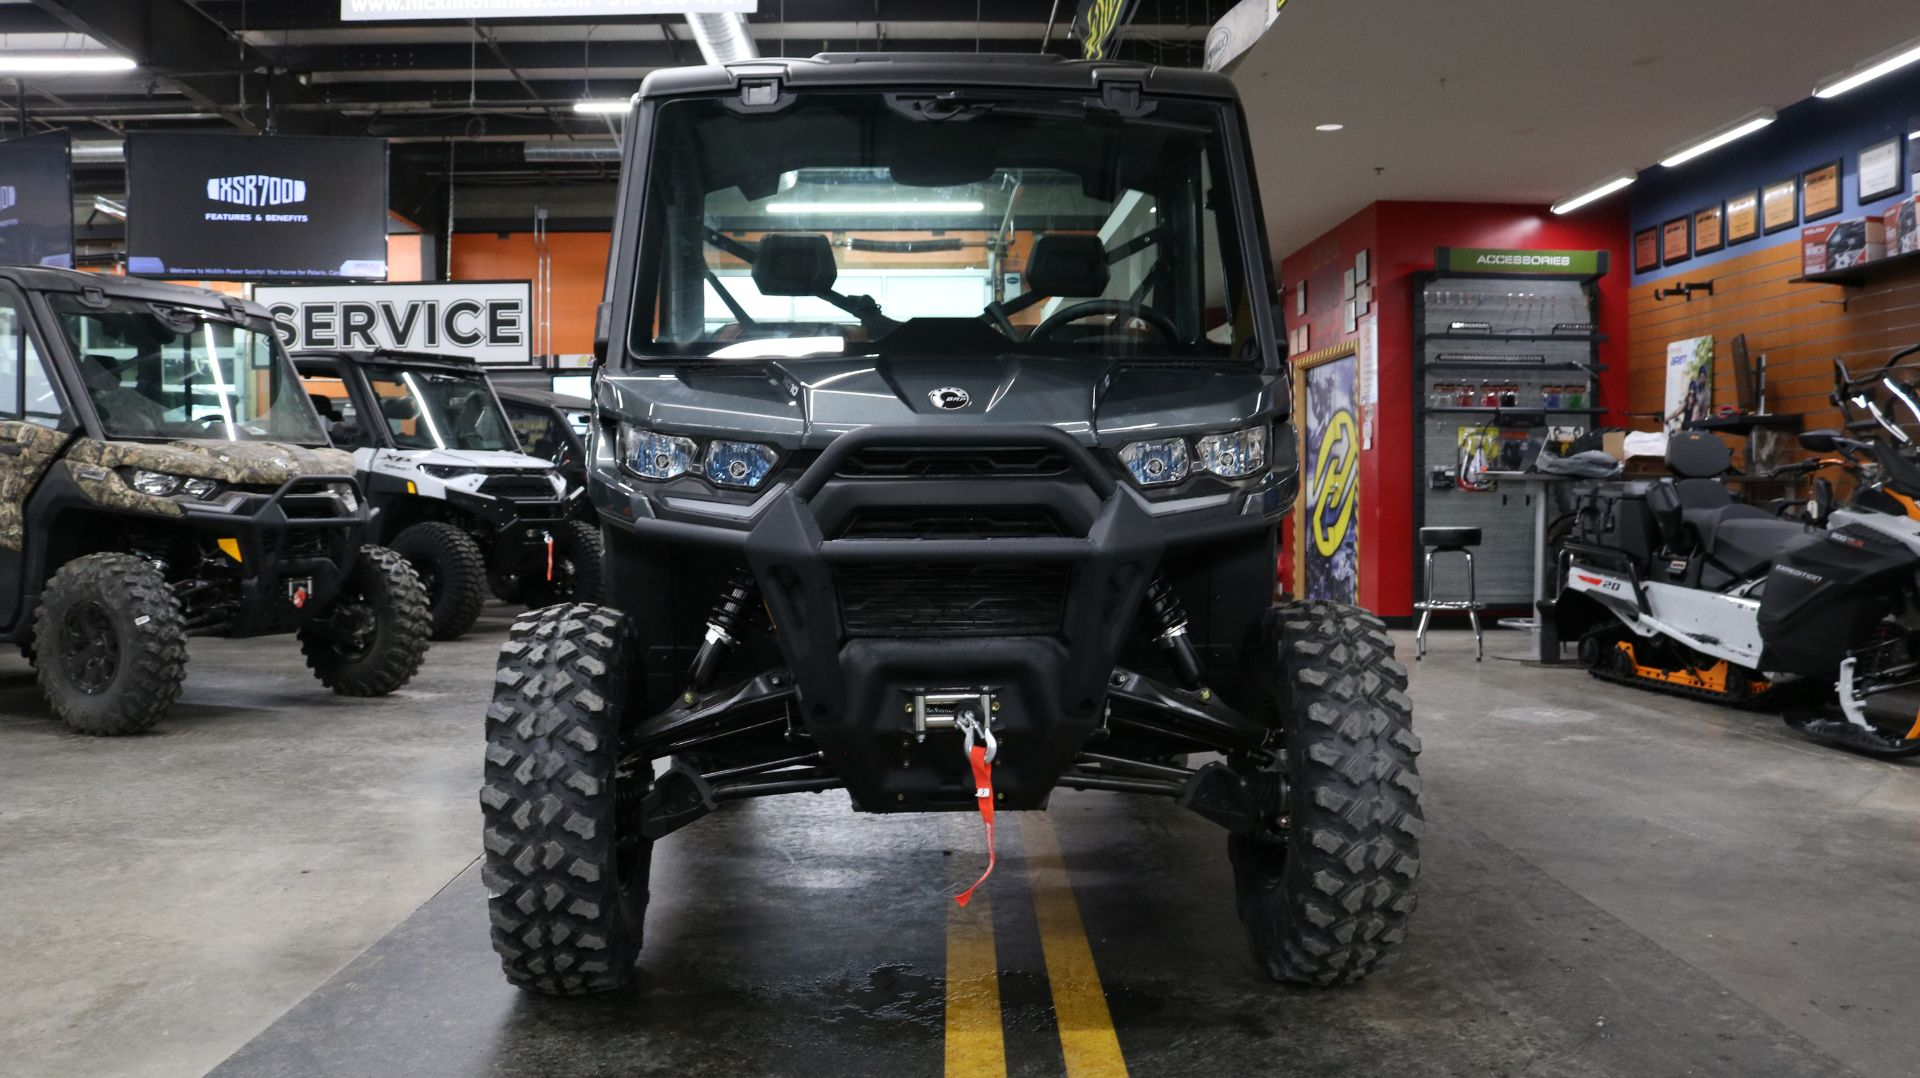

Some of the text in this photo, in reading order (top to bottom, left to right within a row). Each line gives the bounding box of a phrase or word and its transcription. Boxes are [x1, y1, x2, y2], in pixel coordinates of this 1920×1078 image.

[219, 175, 293, 206] XSR700
[205, 213, 252, 221] FEATURES
[265, 214, 308, 222] BENEFITS
[1477, 254, 1570, 266] ACCESSORIES
[265, 299, 522, 350] SERVICE
[1602, 581, 1621, 592] 20
